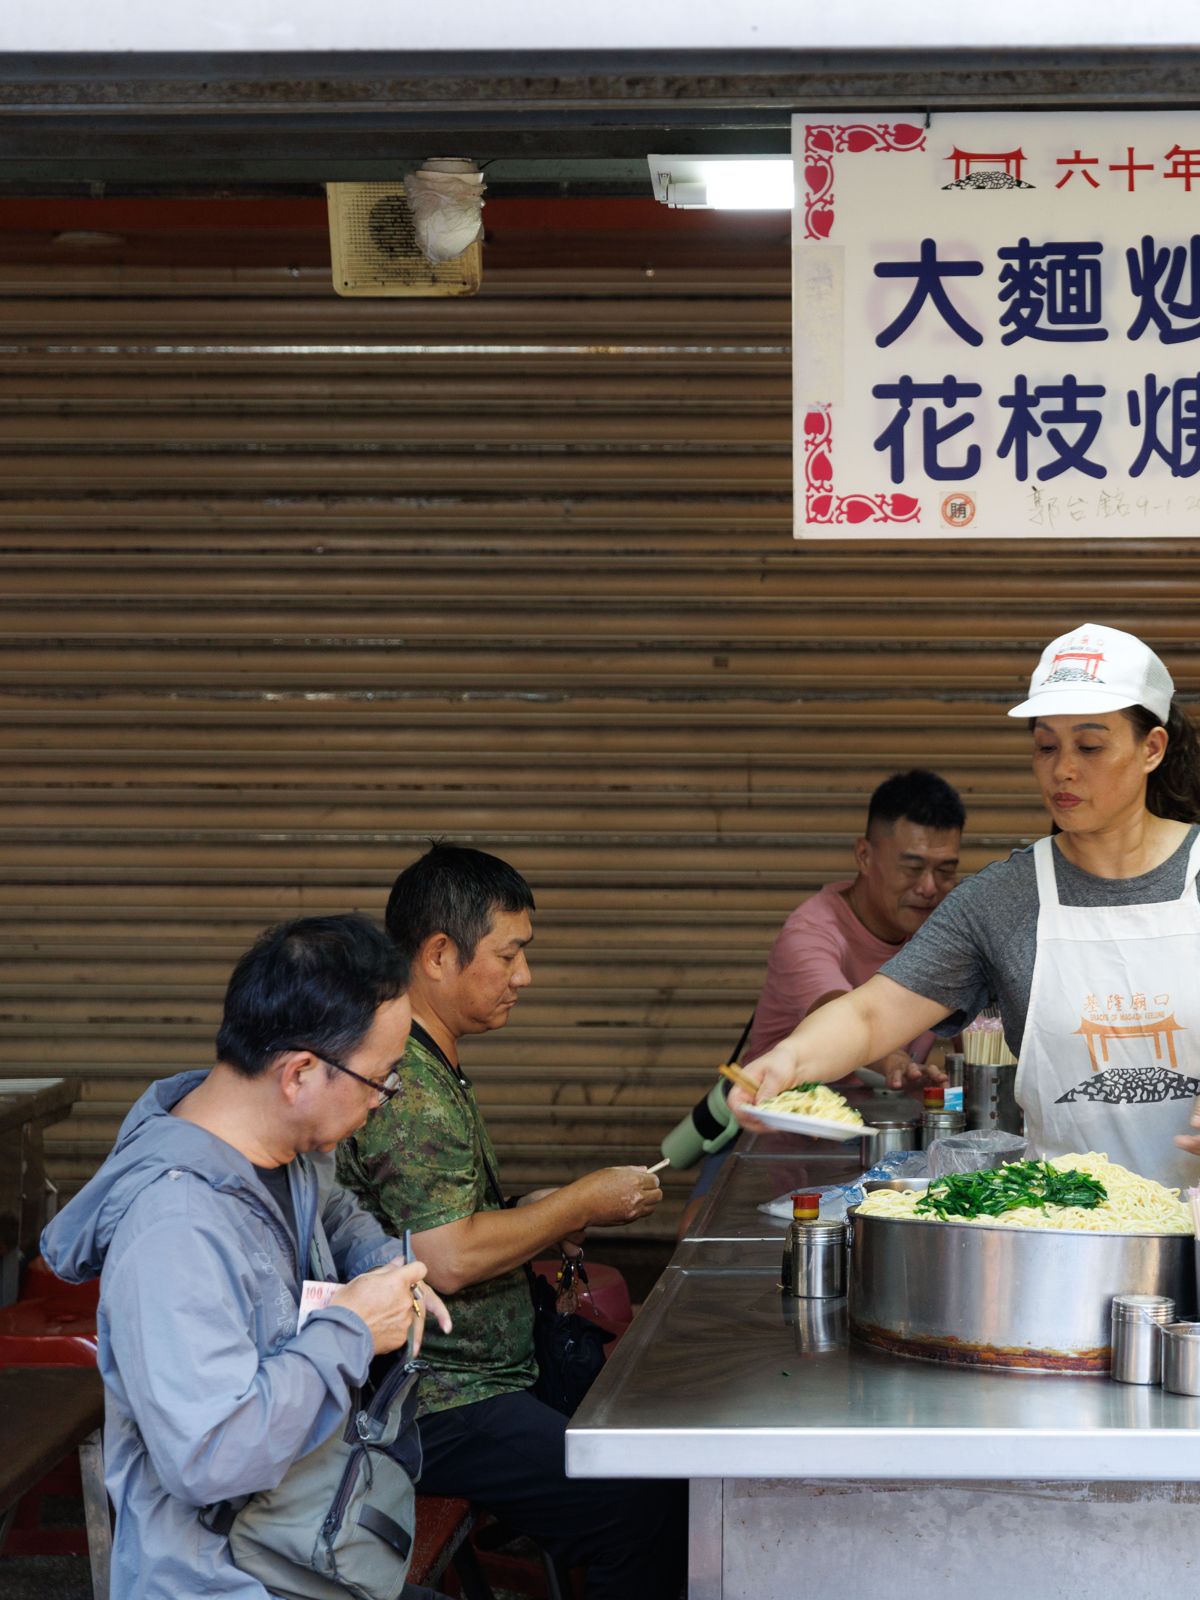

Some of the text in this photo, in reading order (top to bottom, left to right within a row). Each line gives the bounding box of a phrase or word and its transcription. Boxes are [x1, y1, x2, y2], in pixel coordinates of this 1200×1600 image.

[1083, 991, 1169, 1014] 基隆廟口
[305, 1286, 323, 1300] 100
